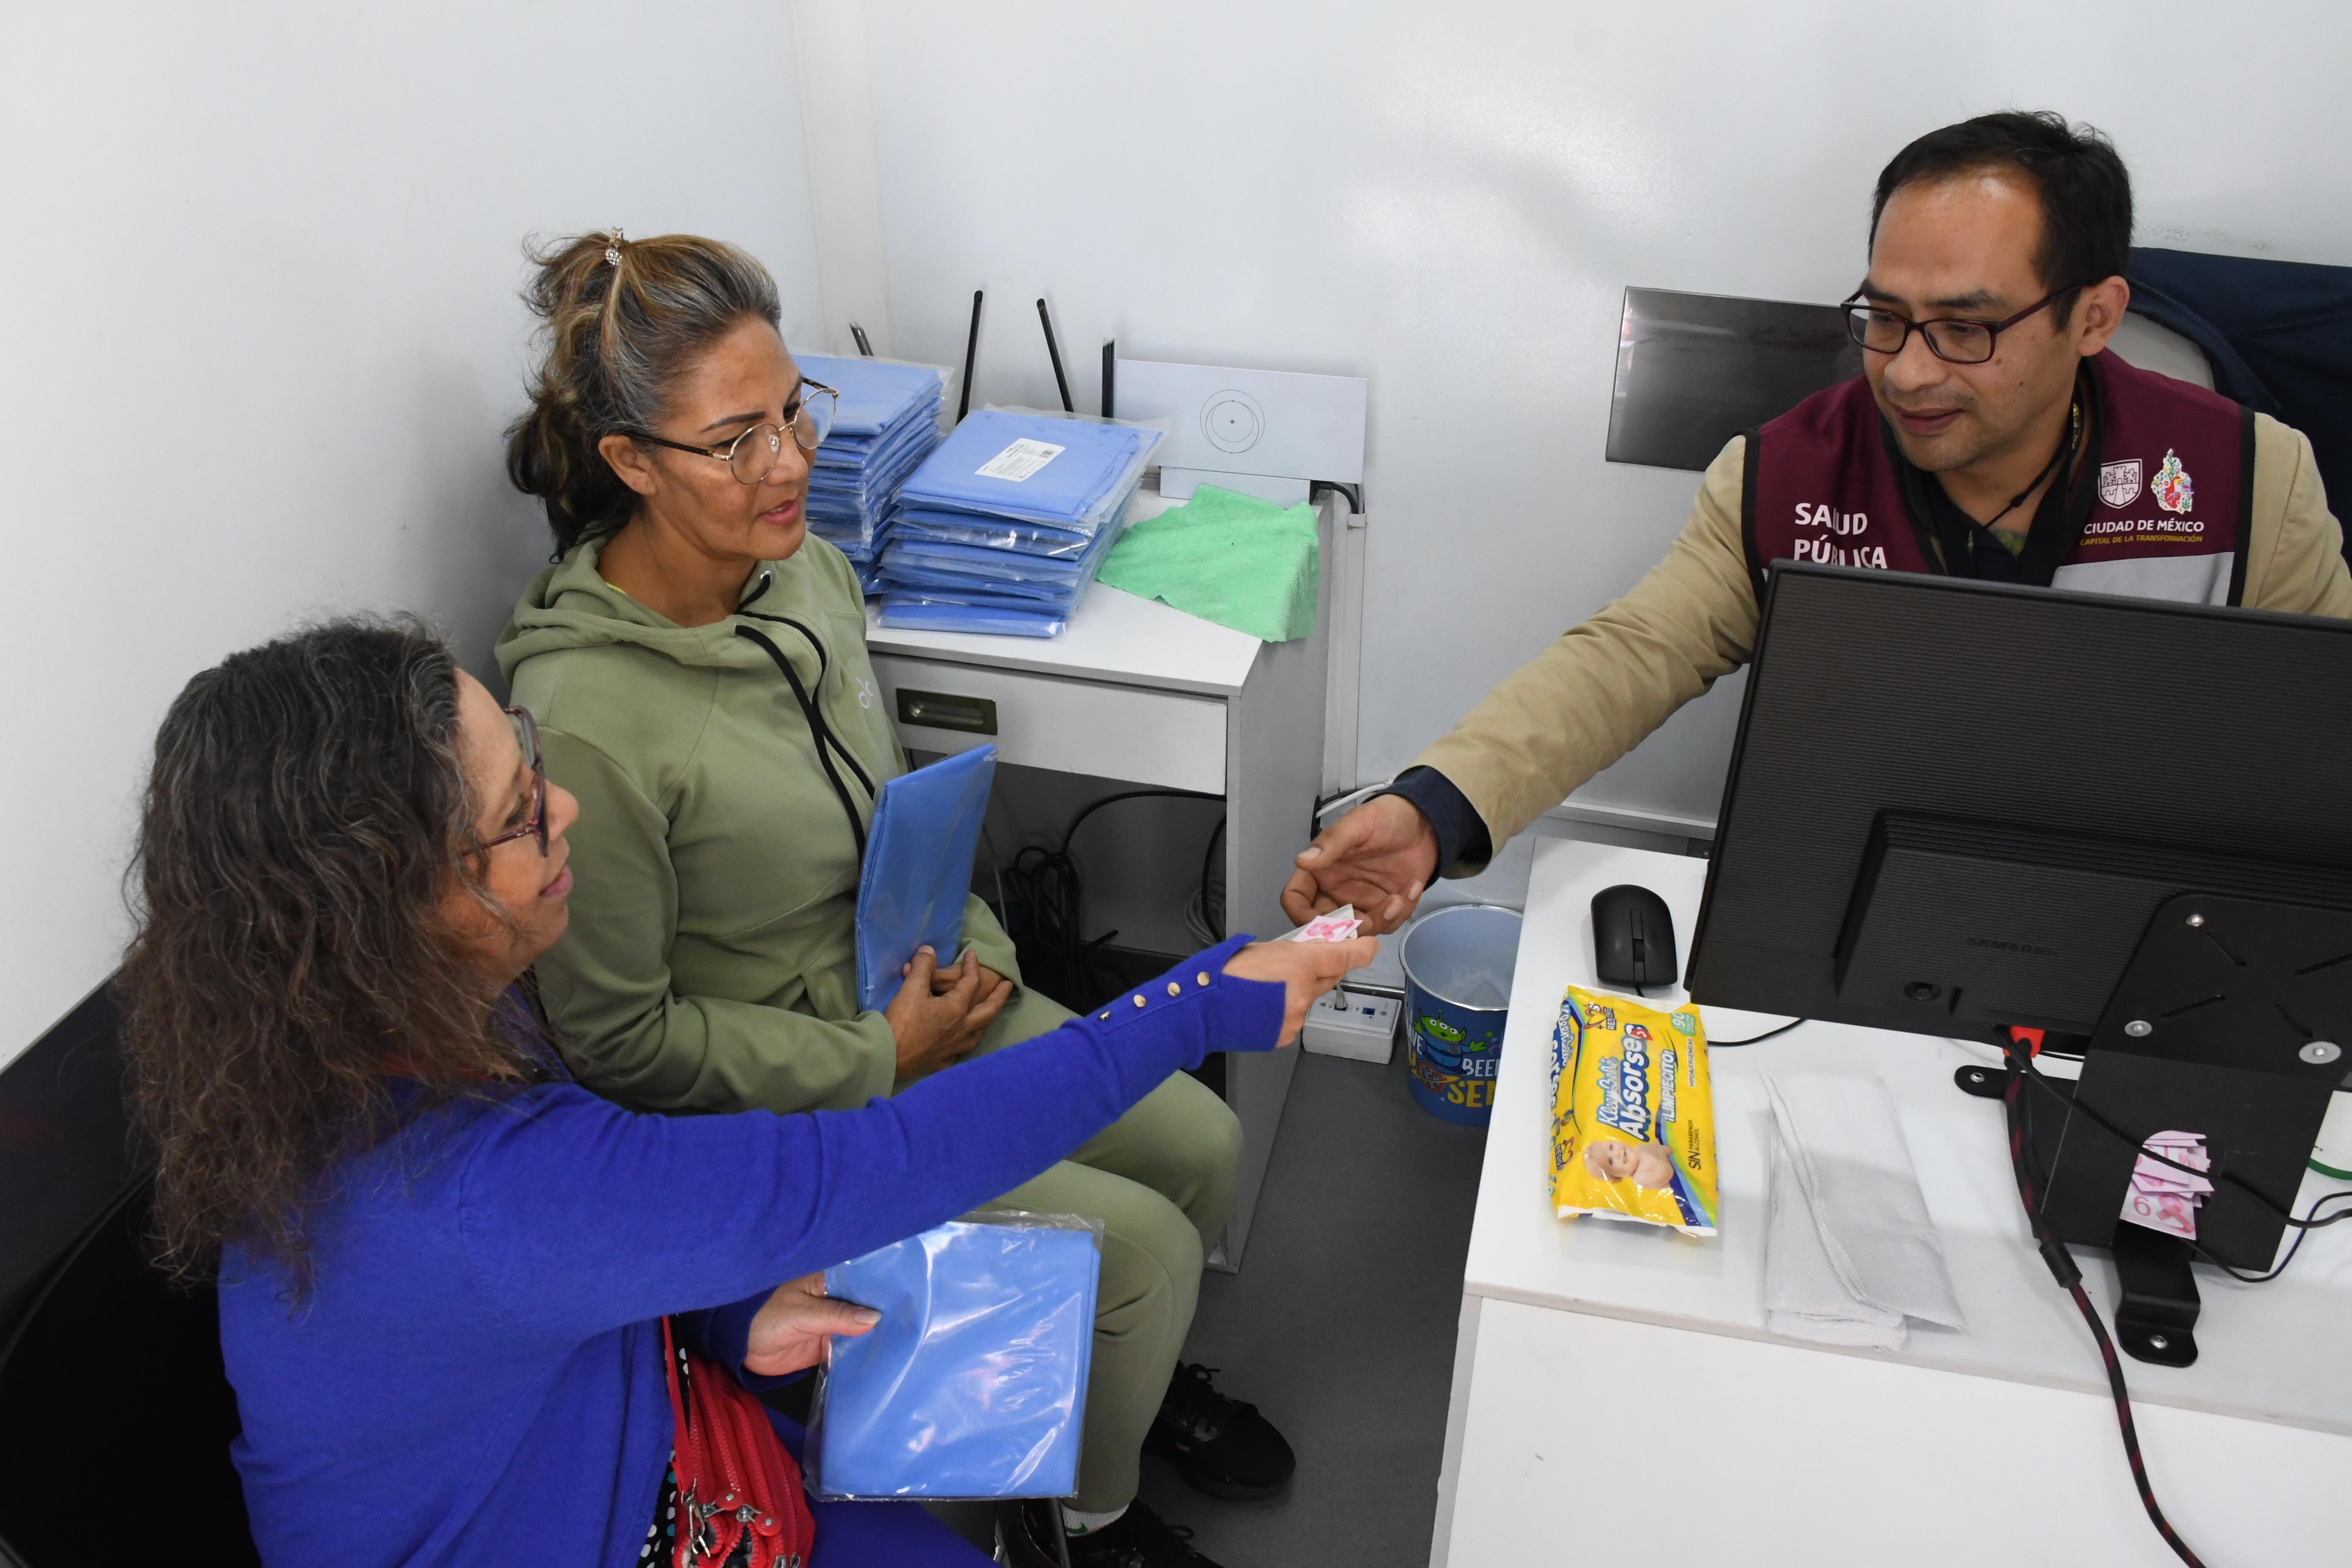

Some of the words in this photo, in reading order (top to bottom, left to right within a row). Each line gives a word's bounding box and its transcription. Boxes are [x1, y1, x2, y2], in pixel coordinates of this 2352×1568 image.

[1795, 503, 1867, 535] SALUD
[2084, 520, 2134, 534] CIUDAD
[2137, 520, 2154, 531] DE
[2157, 518, 2204, 532] MÉXICO
[2080, 537, 2110, 545] CAPITAL
[2136, 534, 2202, 542] TRANSFORMACIÓN
[1661, 1050, 1675, 1122] ¡LIMPIECITO!
[1688, 1150, 1701, 1171] SIN
[2134, 1196, 2151, 1216] 6
